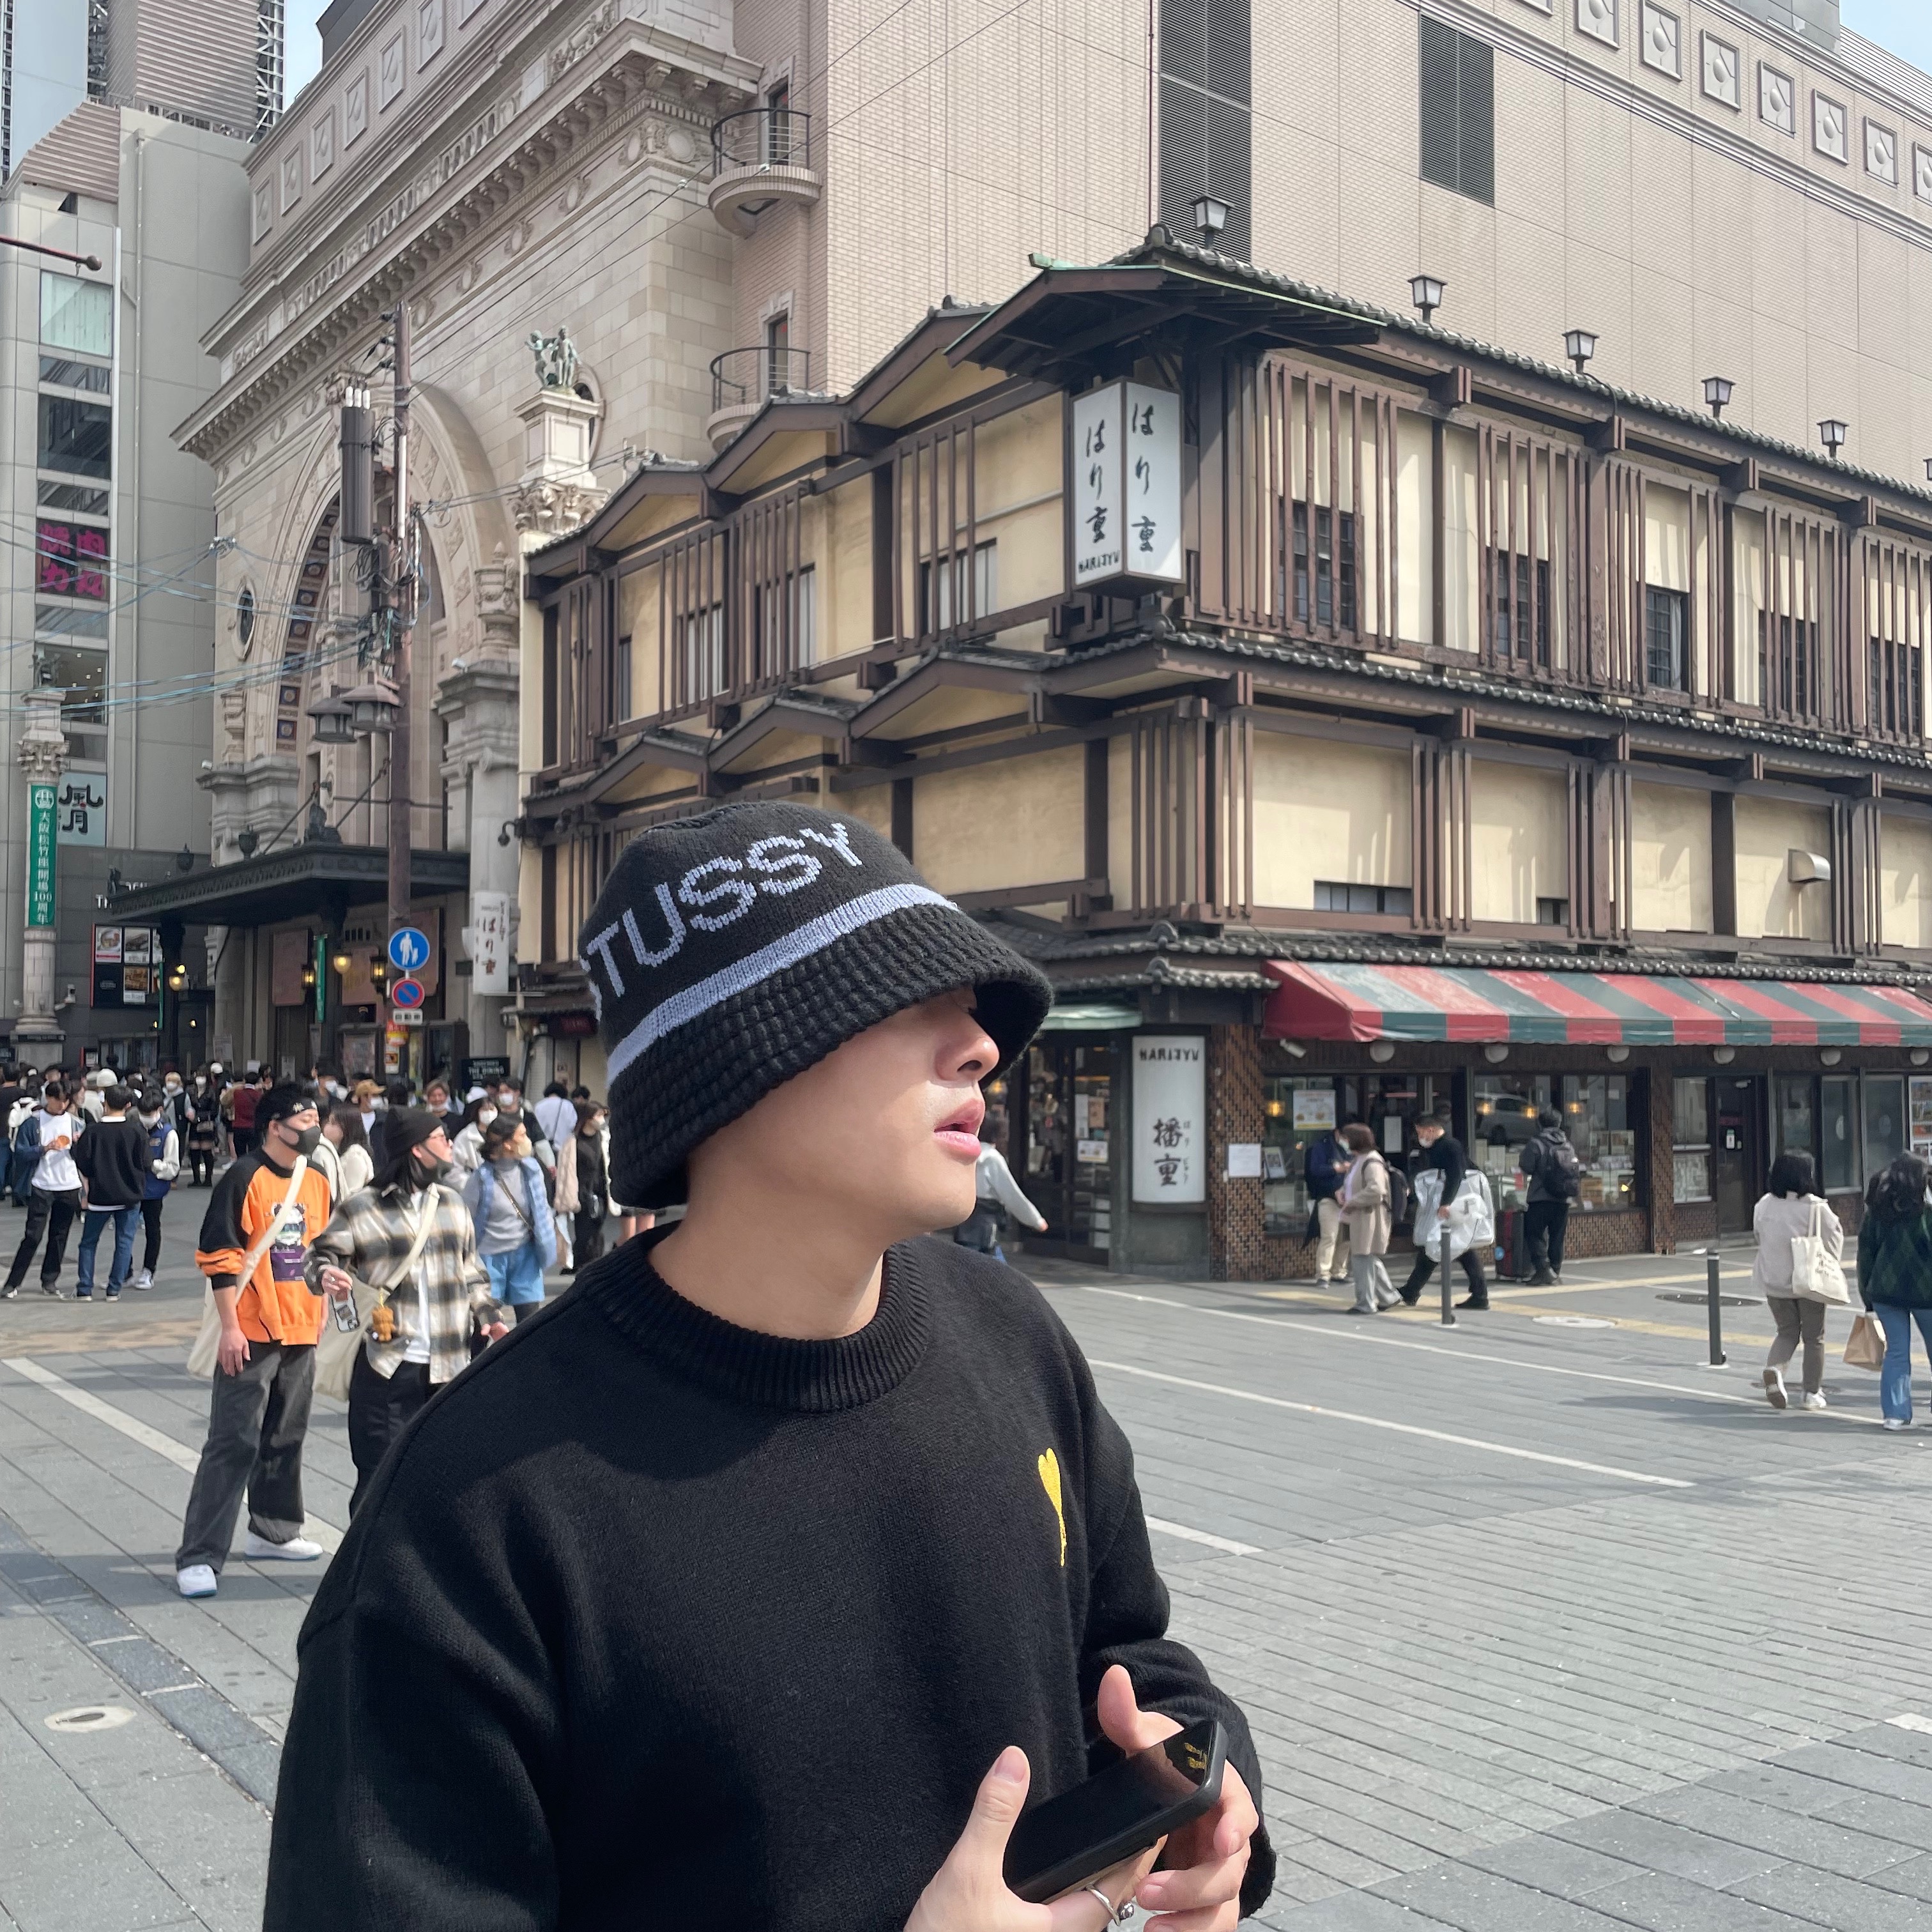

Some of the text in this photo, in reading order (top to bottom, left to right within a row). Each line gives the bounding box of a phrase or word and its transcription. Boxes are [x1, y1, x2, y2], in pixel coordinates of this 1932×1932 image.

[1085, 419, 1108, 544] はり重
[1130, 402, 1156, 552] はり重
[1078, 550, 1119, 573] HARIJYU
[579, 822, 863, 1021] TUSSY
[1139, 1048, 1199, 1061] HARIJYU
[1153, 1117, 1182, 1186] 播重
